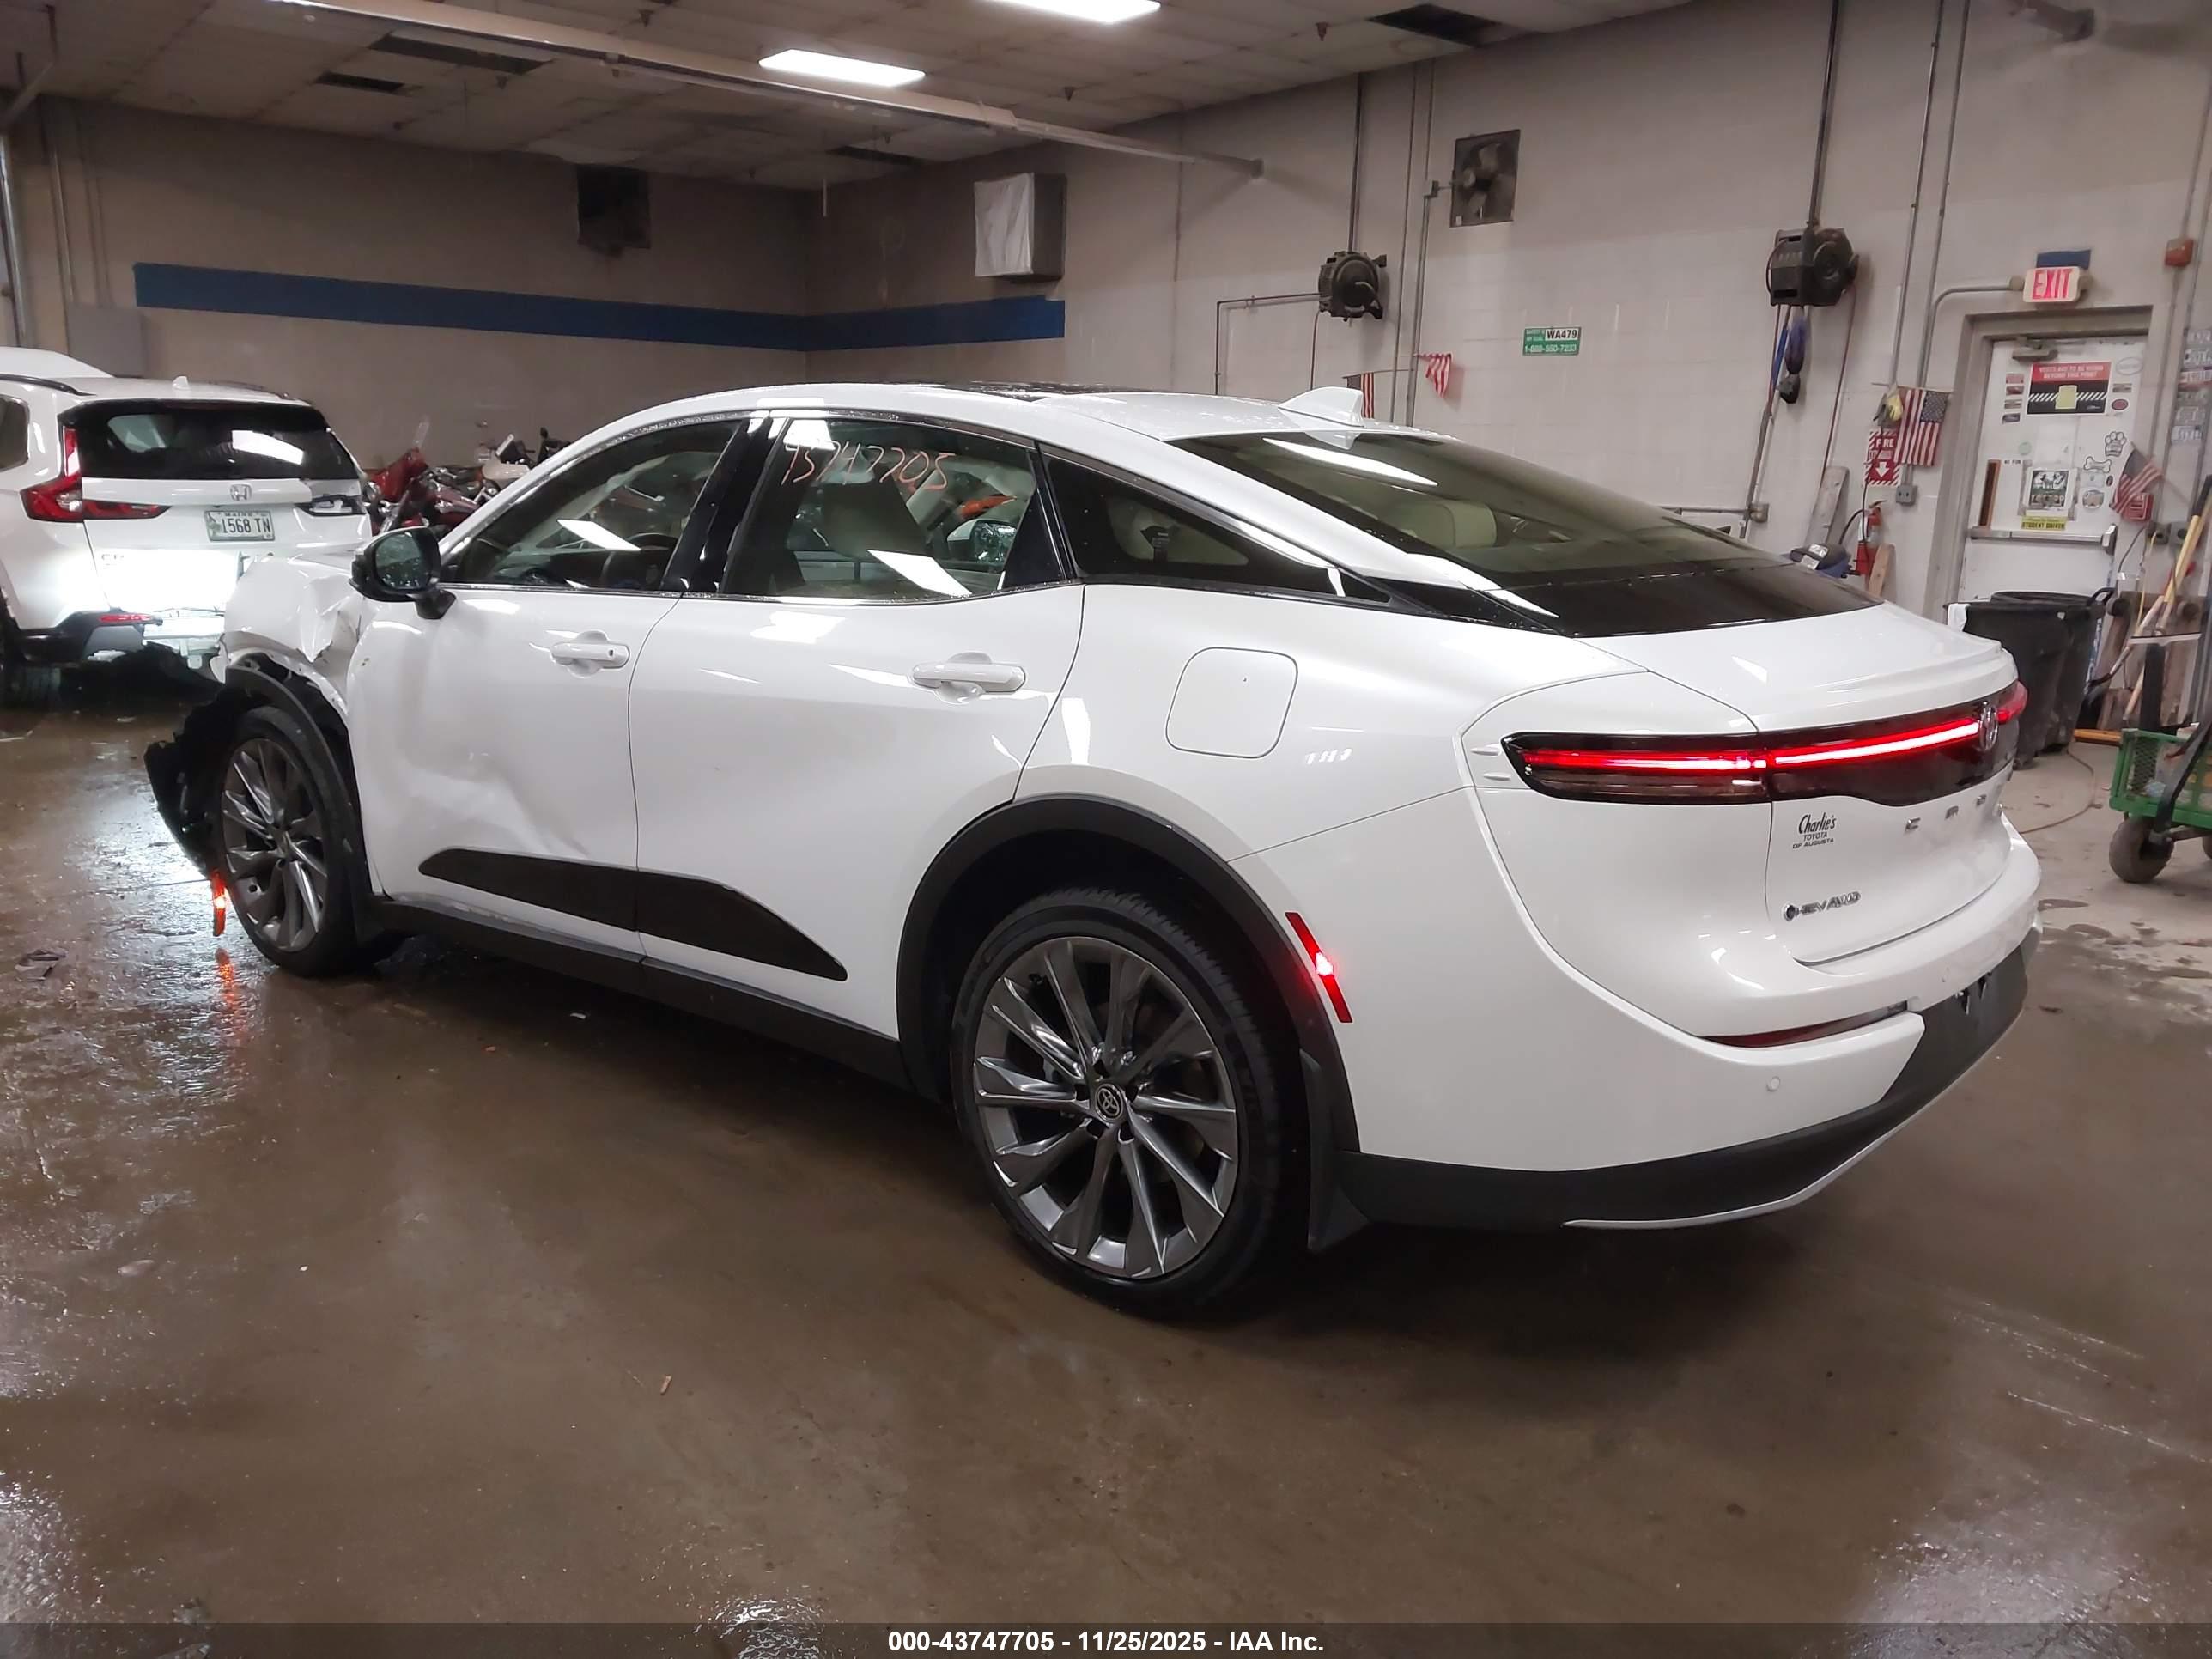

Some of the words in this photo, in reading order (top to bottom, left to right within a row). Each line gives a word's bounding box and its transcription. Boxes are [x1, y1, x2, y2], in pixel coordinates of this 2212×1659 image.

[2033, 268, 2073, 300] EXIT
[1547, 329, 1577, 339] WA479
[222, 518, 252, 533] 1568
[254, 517, 271, 533] TN
[1798, 811, 1838, 835] Charlie's
[1803, 830, 1828, 842] TOYOTA
[1803, 837, 1834, 848] AUGUSTA
